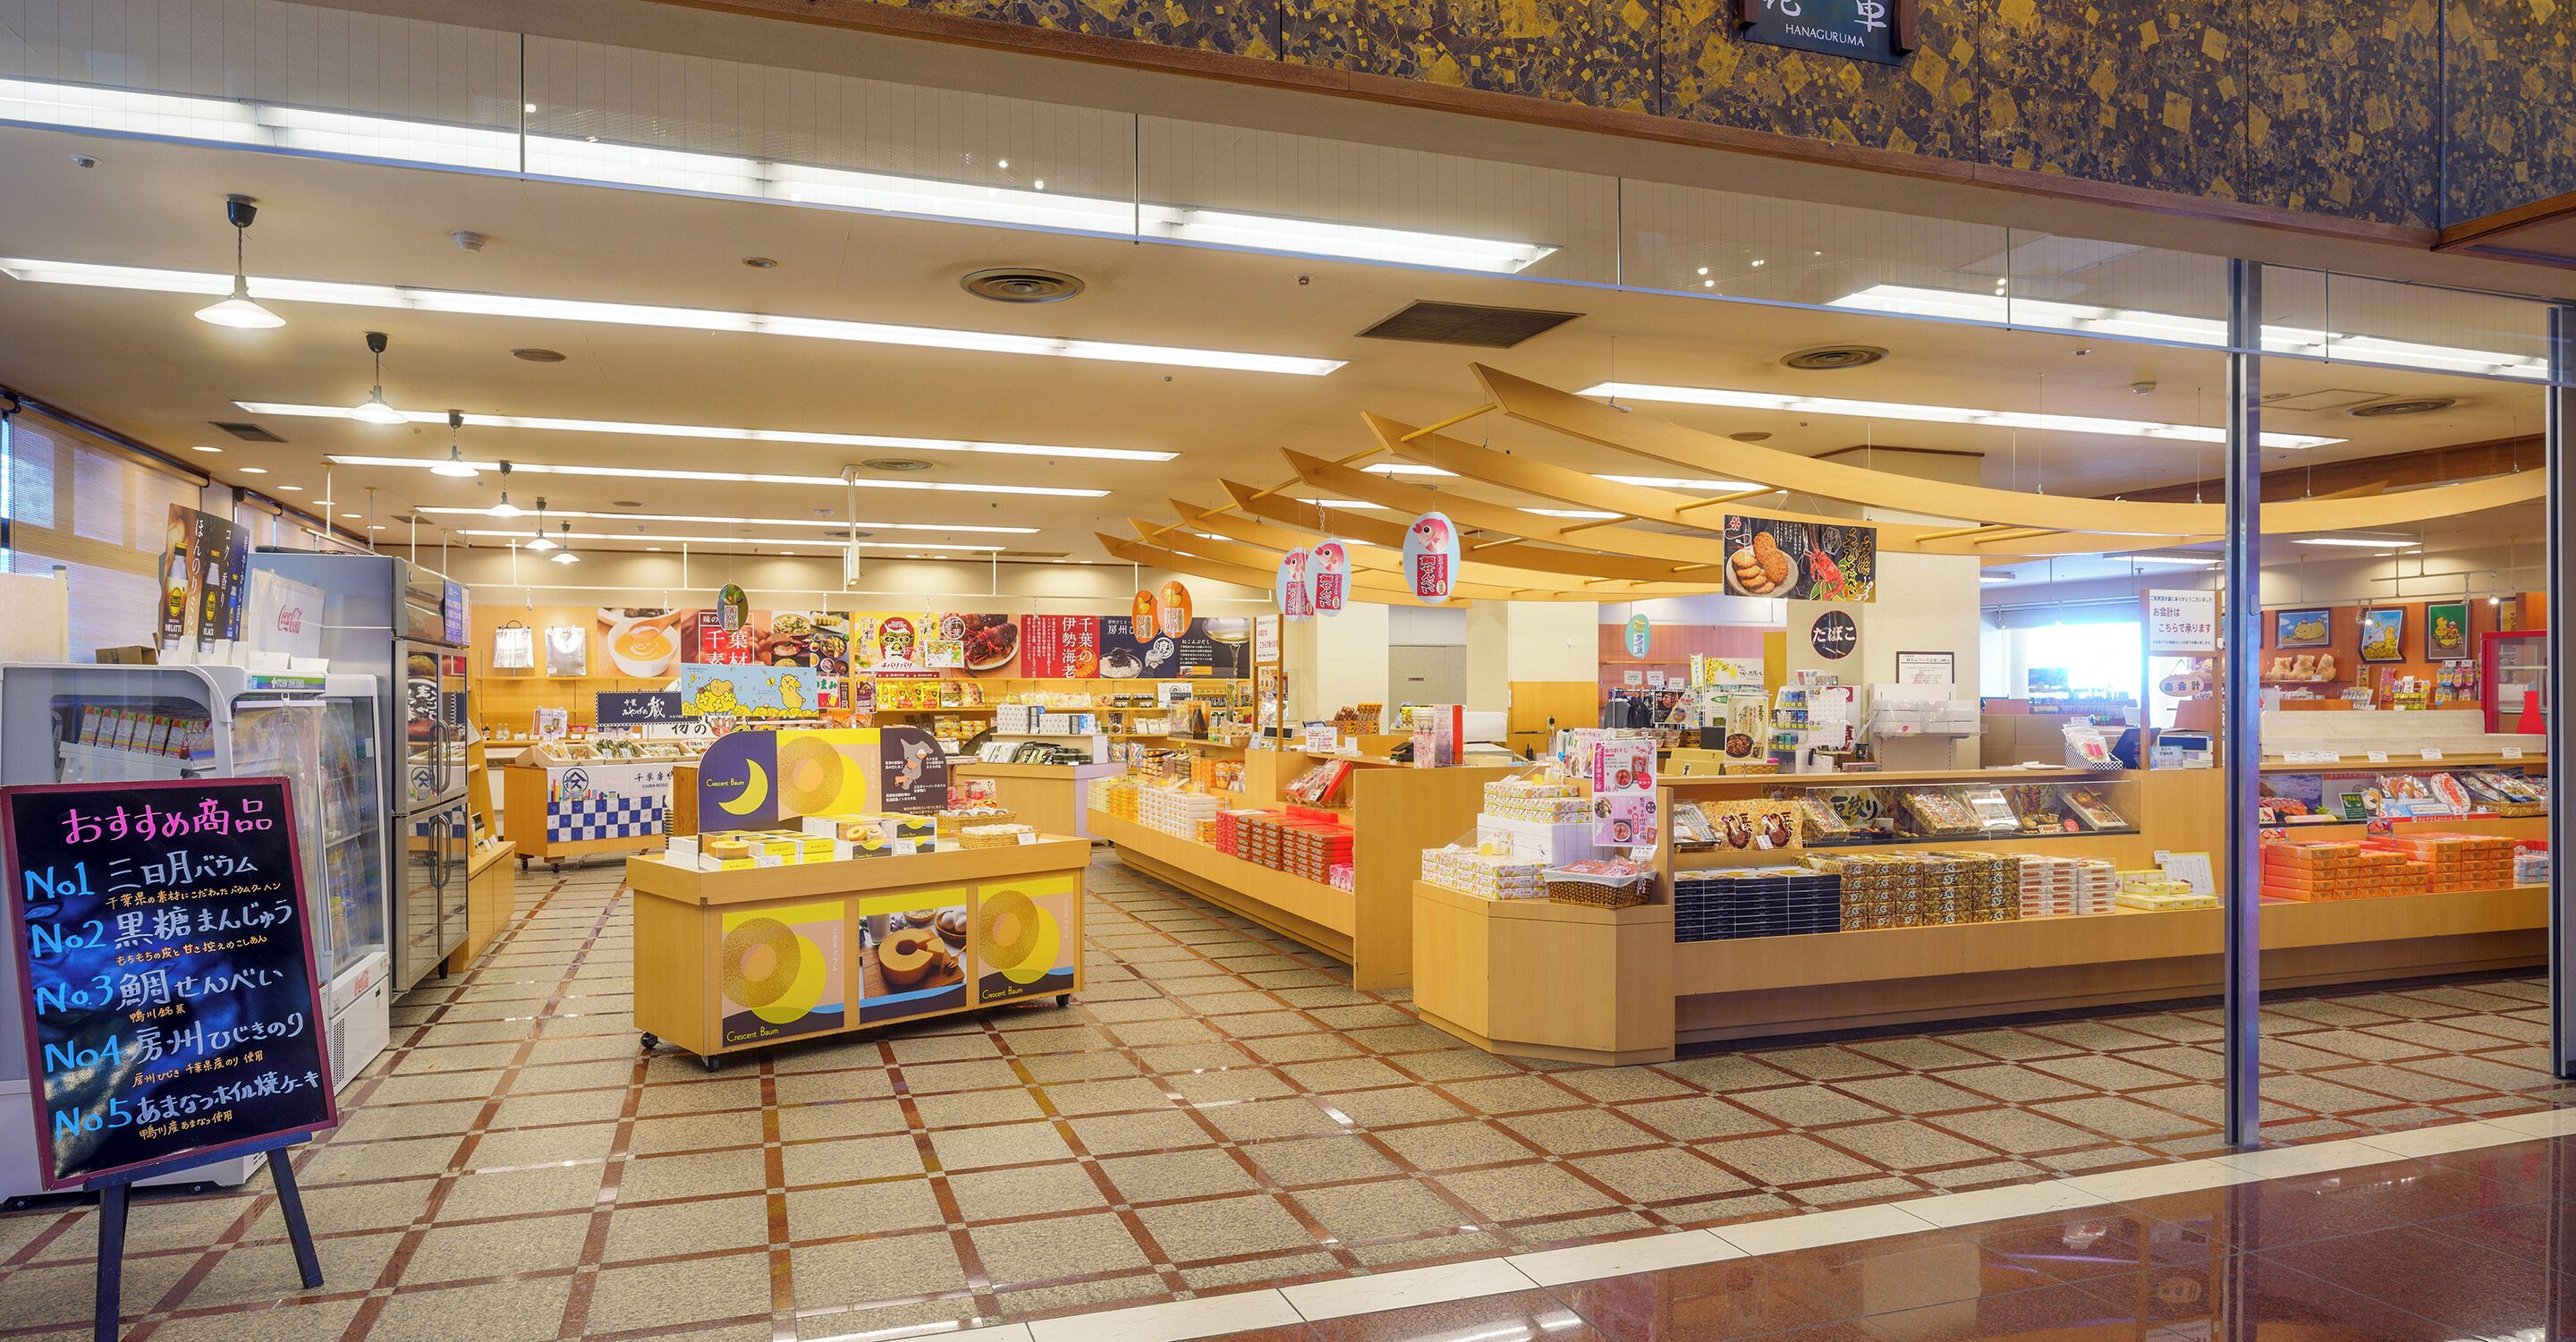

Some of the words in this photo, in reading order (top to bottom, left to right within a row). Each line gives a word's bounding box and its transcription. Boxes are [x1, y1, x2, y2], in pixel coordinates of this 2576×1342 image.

[1785, 24, 1865, 47] HANAGURUMA
[2153, 607, 2180, 617] お会計は
[1812, 625, 1856, 644] たばこ
[2158, 623, 2211, 633] こちらで承ります
[705, 630, 749, 650] 千葉
[1062, 616, 1077, 678] 伊勢海老
[1079, 617, 1093, 663] 千葉の
[706, 651, 749, 665] 素材
[2164, 681, 2200, 692] お会計
[706, 778, 729, 787] Crescent
[730, 777, 745, 787] Baum
[1830, 794, 1878, 820] 豆絞り
[62, 798, 273, 844] おすすめ商品
[25, 862, 94, 900] No1
[107, 850, 258, 892] 三日月バウム
[32, 920, 106, 957] No2
[114, 899, 293, 949] 黒糖まんじゅう
[37, 975, 113, 1015] No3
[116, 968, 284, 1011] 鯛せんべい
[982, 989, 1006, 999] Crescent
[1008, 986, 1023, 995] Baum
[129, 1004, 186, 1023] 鴨川銘菓
[45, 1034, 120, 1073] No4
[128, 1012, 304, 1065] 房州ひじきのり
[726, 1030, 758, 1043] Crescent
[759, 1025, 779, 1038] Baum
[55, 1098, 131, 1142] No5
